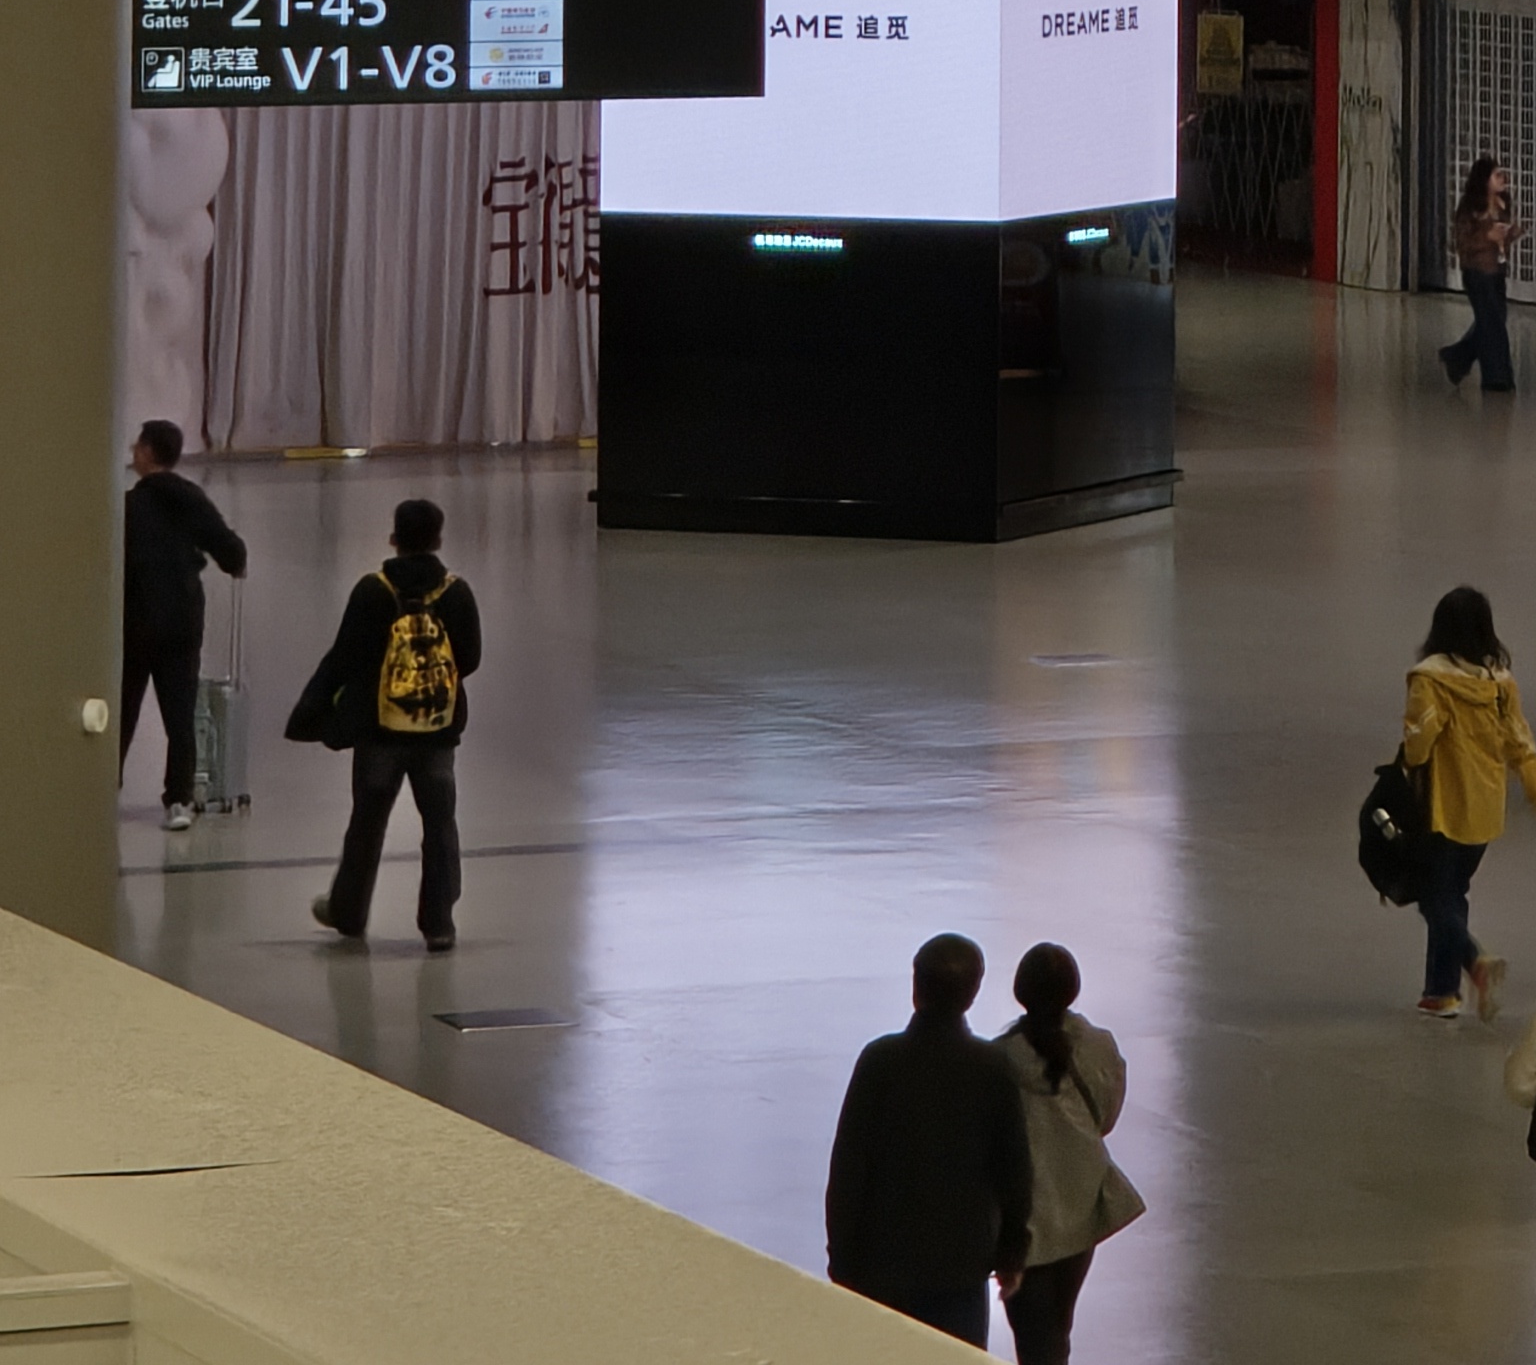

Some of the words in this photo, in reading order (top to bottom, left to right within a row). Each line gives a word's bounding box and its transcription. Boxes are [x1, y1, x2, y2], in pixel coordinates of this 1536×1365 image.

[142, 13, 189, 29] Gates
[856, 15, 909, 39] 追觅
[1042, 9, 1110, 38] DREAME
[189, 47, 259, 71] 贵宾室
[283, 44, 456, 91] V1-V8
[190, 73, 214, 89] VIP
[216, 72, 271, 90] Lounge
